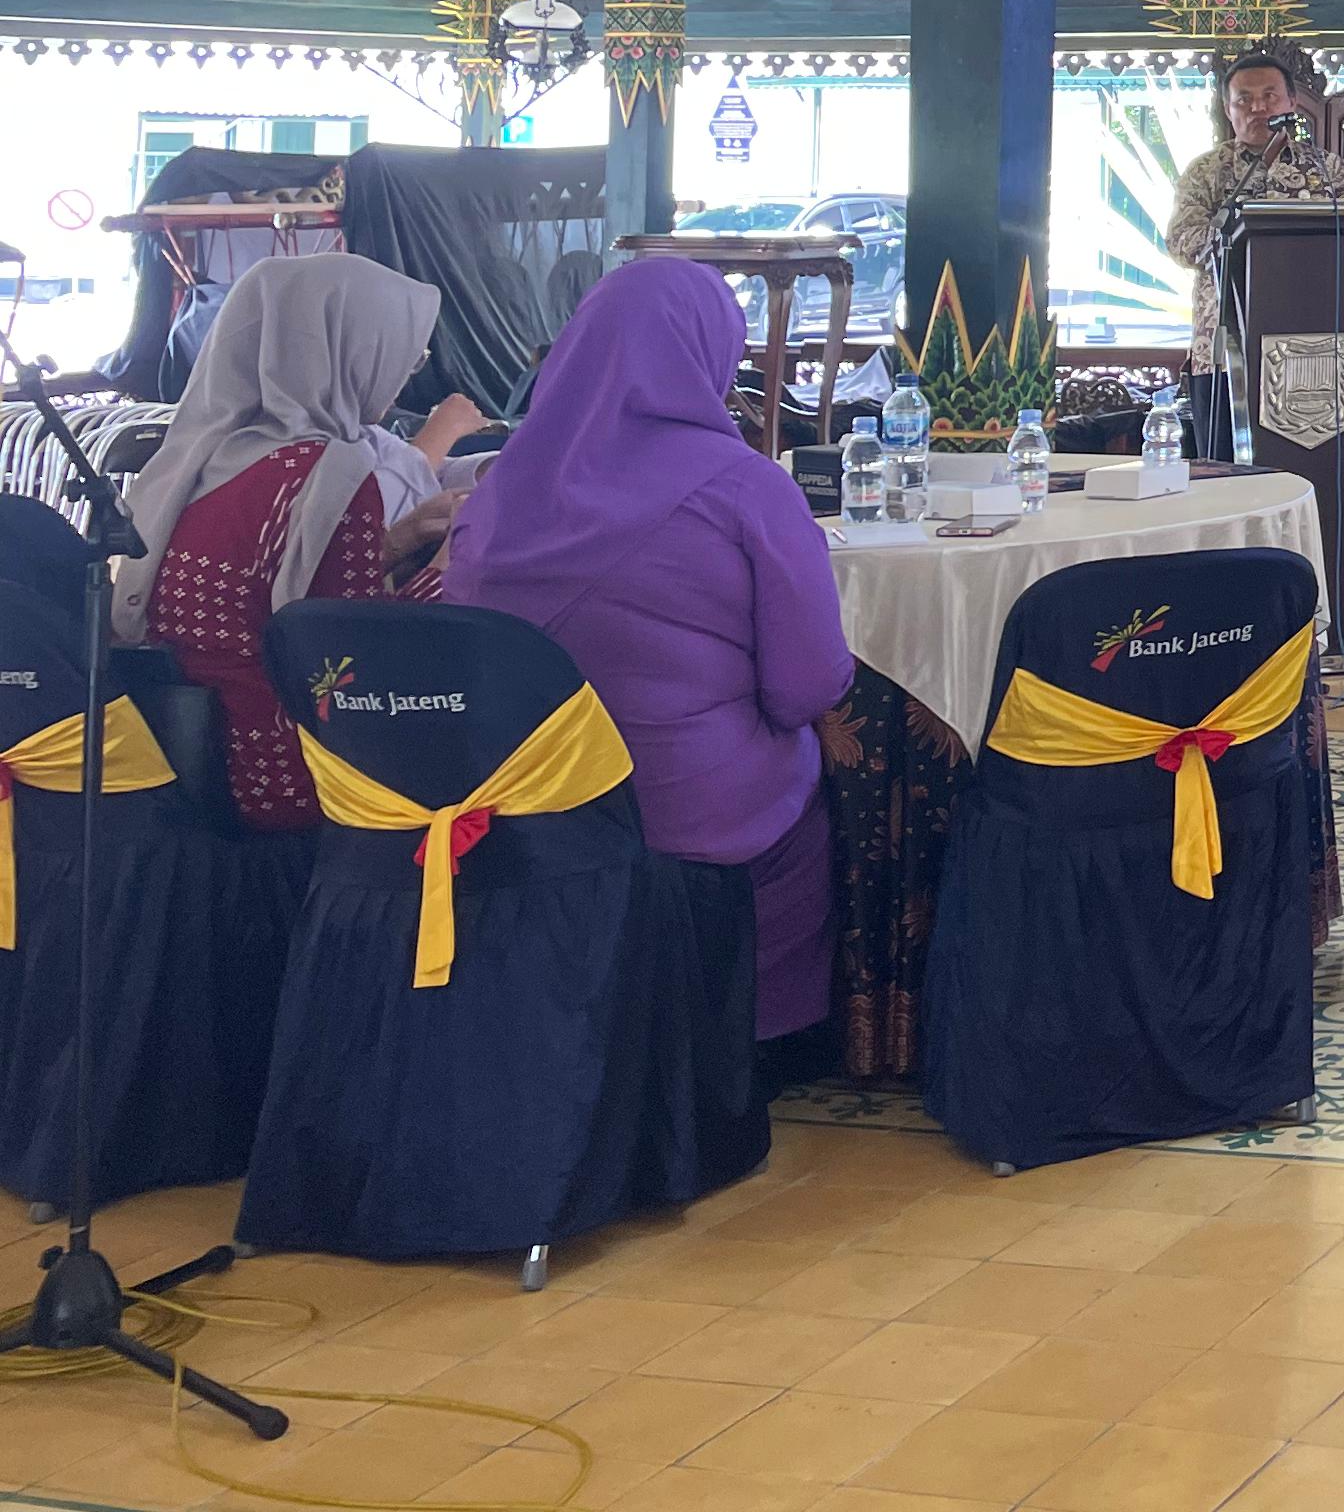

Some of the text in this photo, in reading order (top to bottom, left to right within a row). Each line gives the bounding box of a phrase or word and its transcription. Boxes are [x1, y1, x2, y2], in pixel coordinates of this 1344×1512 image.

[1129, 624, 1254, 658] Bank Jateng
[333, 691, 466, 716] Bank Jateng
